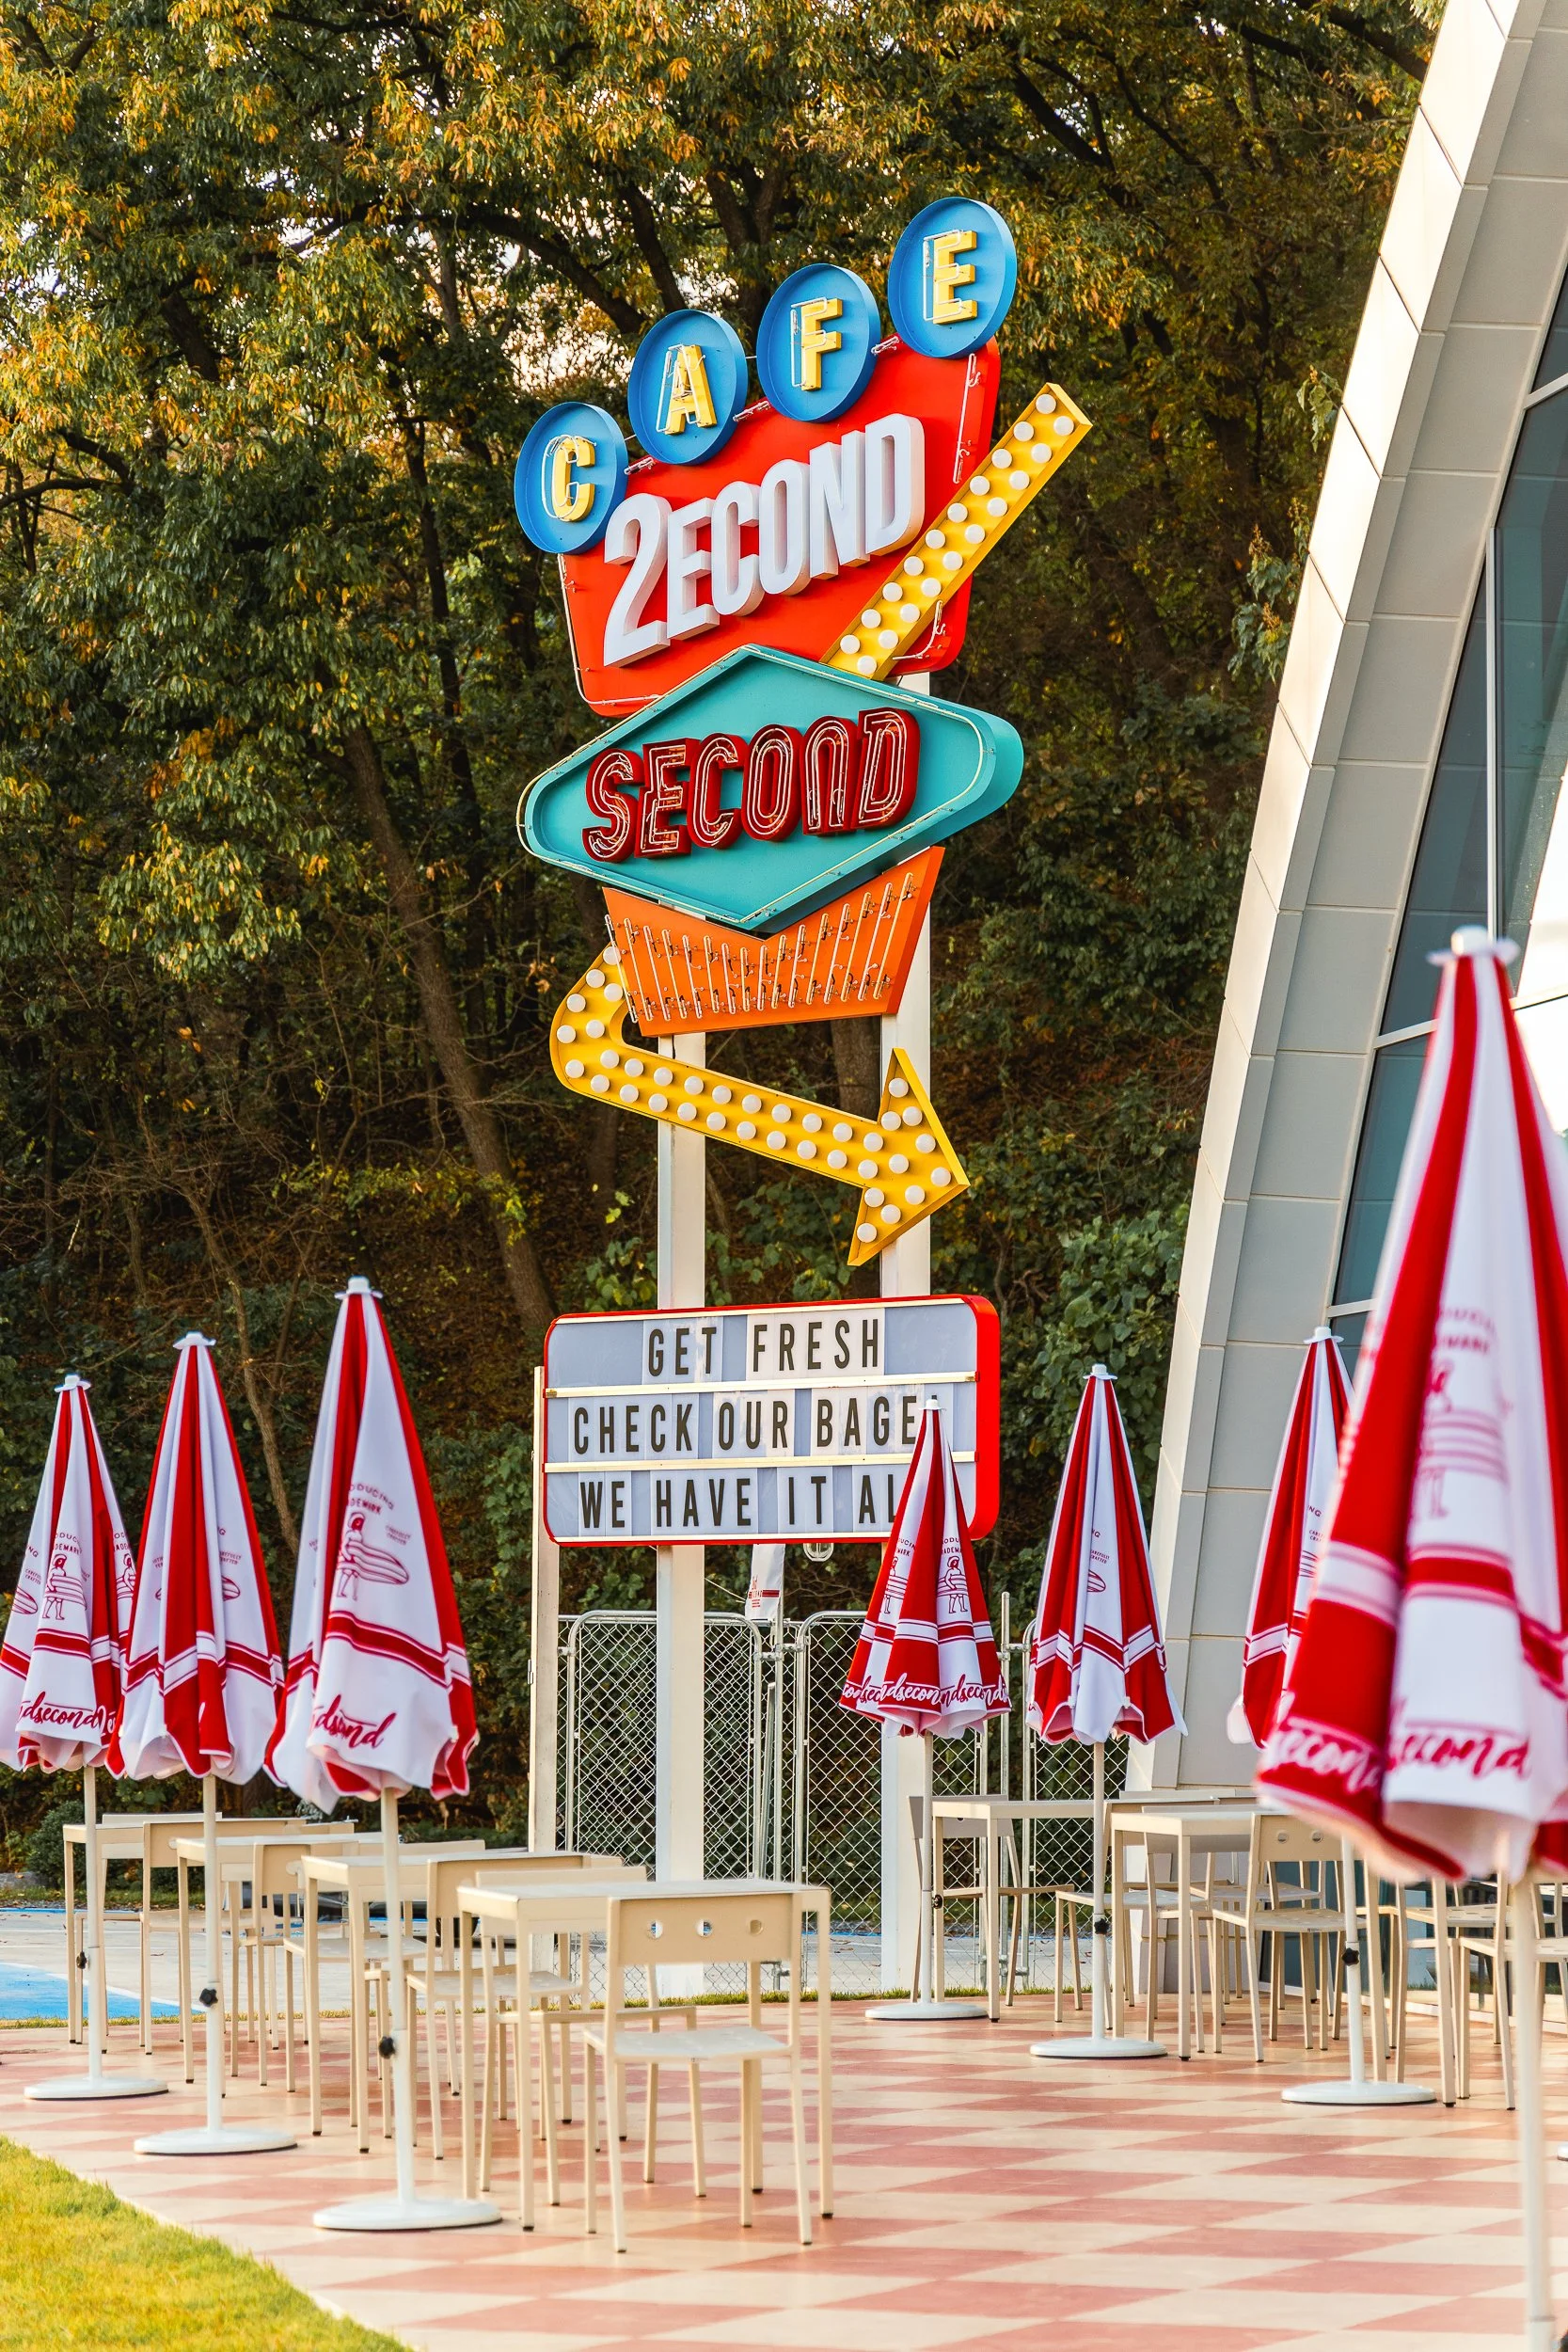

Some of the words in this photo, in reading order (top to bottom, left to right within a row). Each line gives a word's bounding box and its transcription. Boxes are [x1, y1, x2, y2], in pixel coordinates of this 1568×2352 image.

[541, 230, 978, 523] CAFE
[603, 412, 925, 668] 2ECOND
[581, 707, 920, 864] SECOND
[648, 1327, 718, 1377] GET
[752, 1319, 879, 1373] FRESH
[574, 1403, 693, 1455] CHECK
[718, 1400, 788, 1451] OUR
[816, 1394, 938, 1448] BAGE
[580, 1480, 625, 1529] WE
[656, 1477, 752, 1528] HAVE
[788, 1475, 827, 1525] IT
